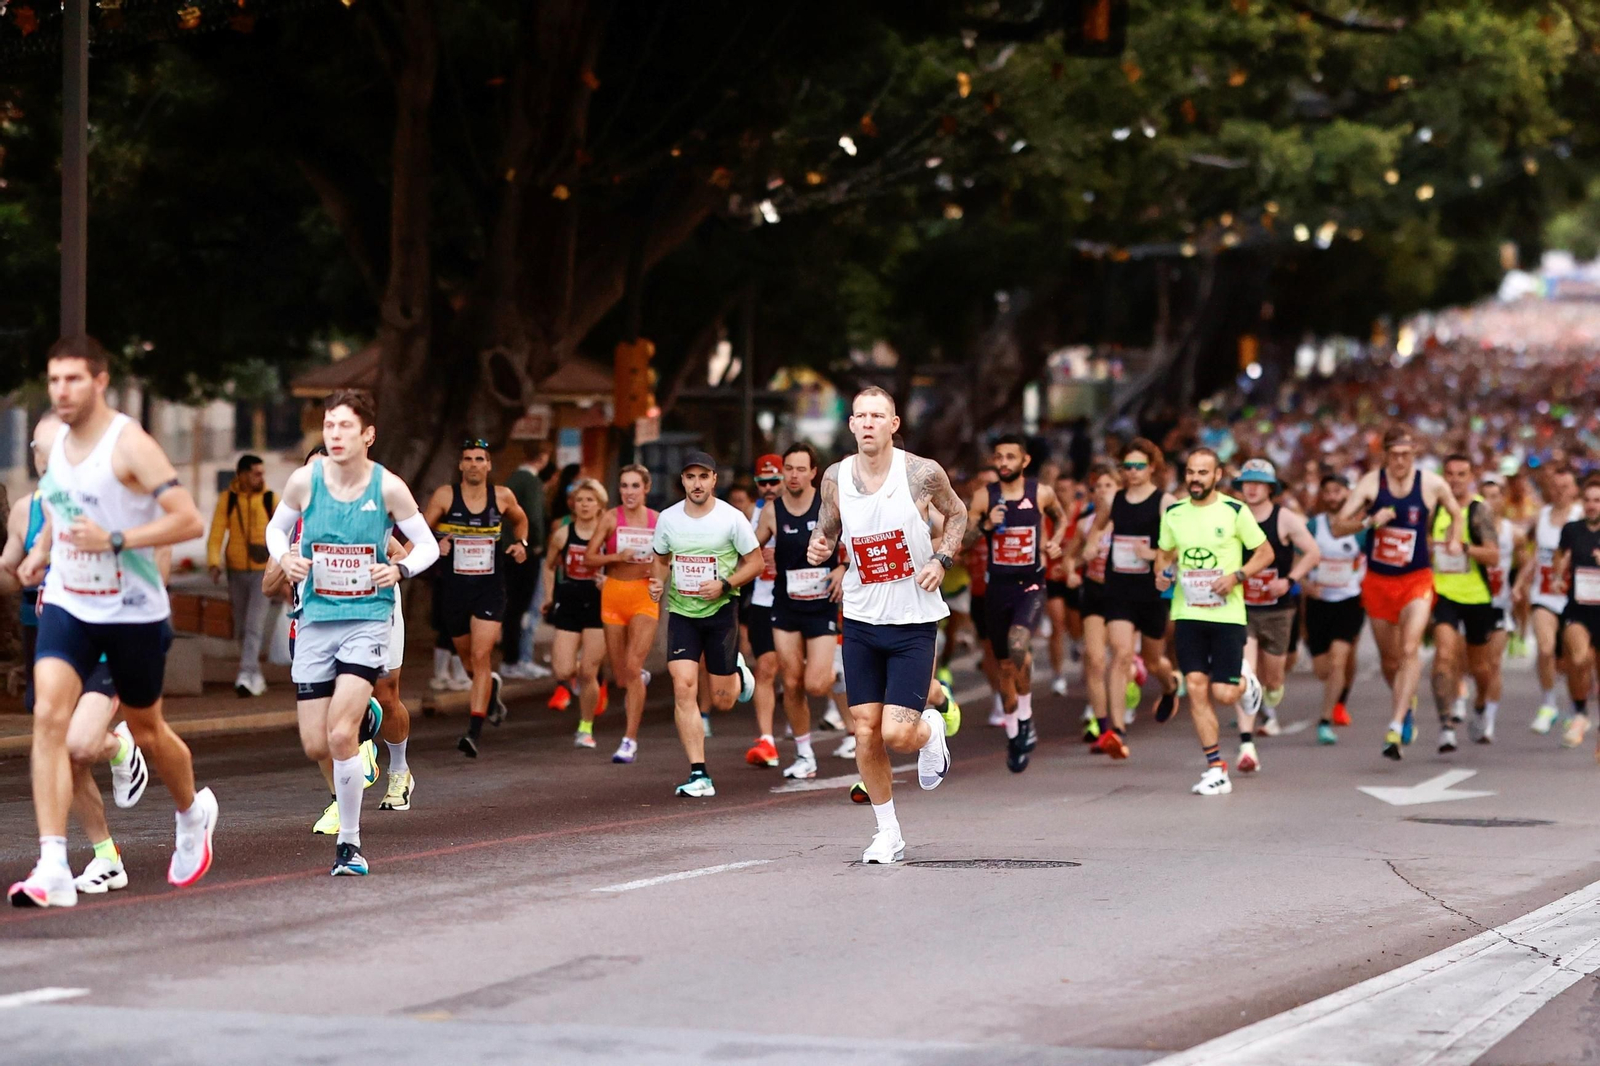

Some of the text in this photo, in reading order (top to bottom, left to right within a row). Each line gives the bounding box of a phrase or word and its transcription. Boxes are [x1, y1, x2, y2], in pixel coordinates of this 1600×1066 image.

[861, 531, 896, 544] GENERALI
[327, 546, 366, 554] GENERALI
[866, 544, 888, 557] 364
[325, 557, 360, 568] 14708
[681, 565, 706, 573] 15447
